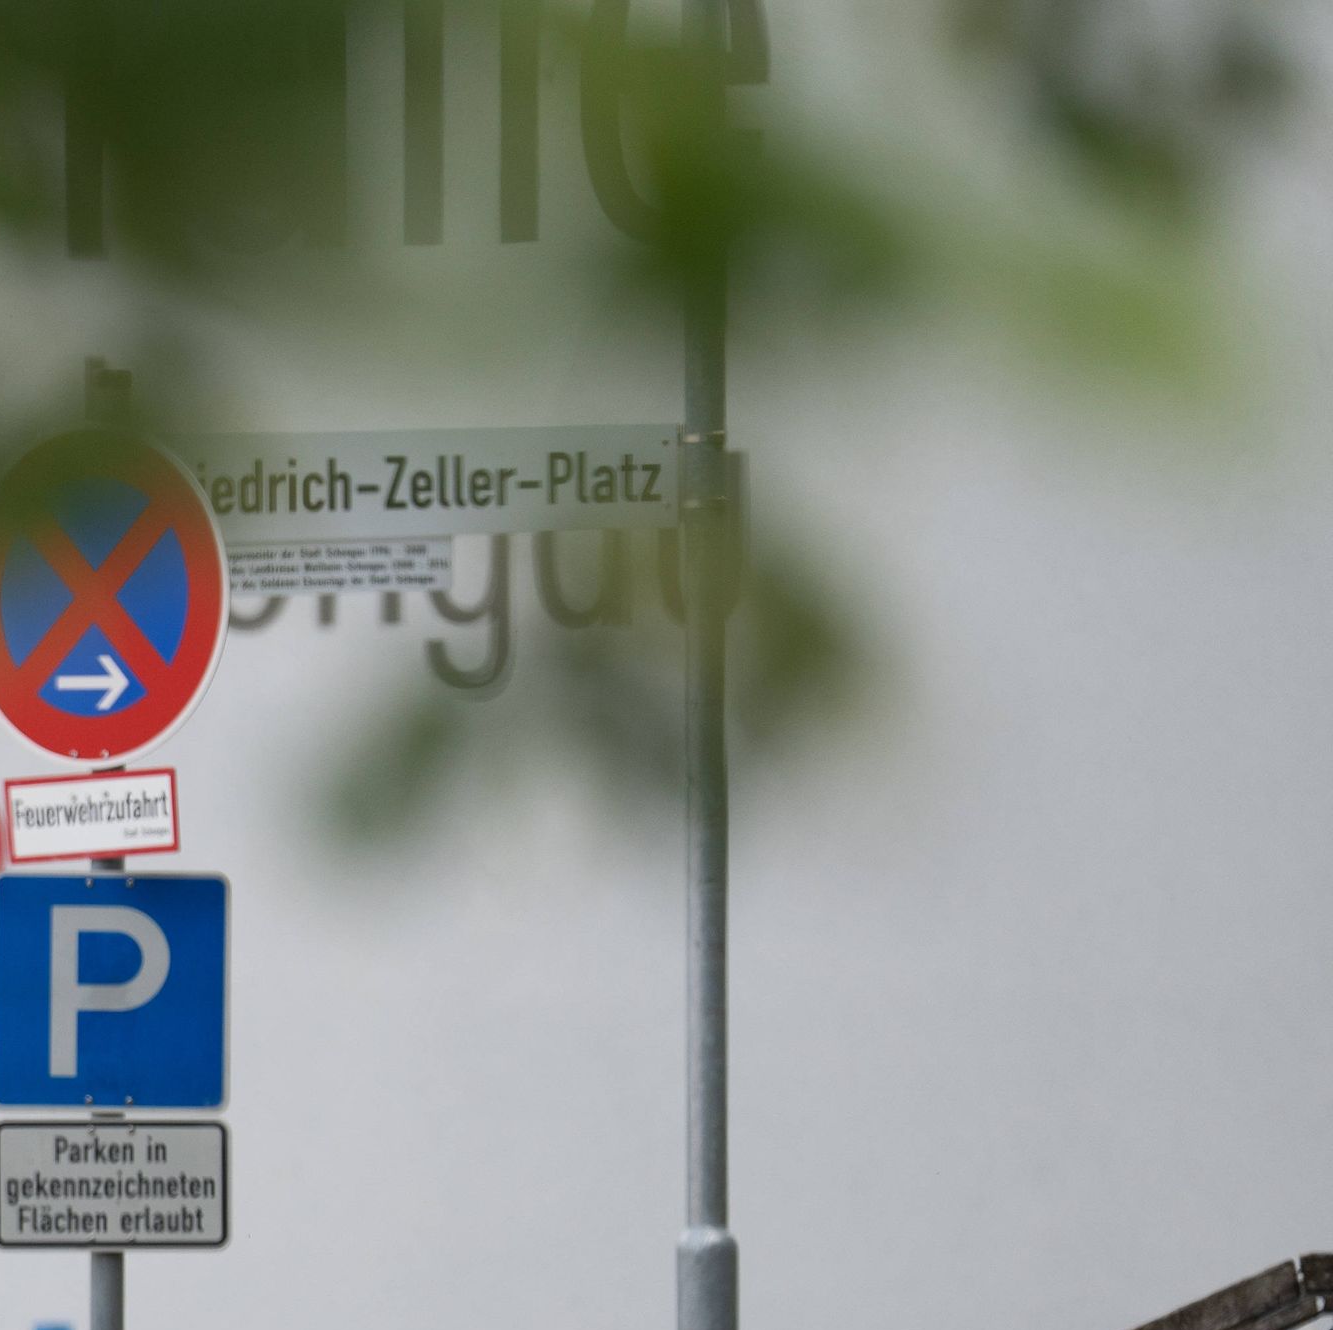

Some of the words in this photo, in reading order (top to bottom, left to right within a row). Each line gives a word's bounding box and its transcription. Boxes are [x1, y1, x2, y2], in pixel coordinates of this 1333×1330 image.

[196, 451, 663, 515] iedrich-Zeller-Platz
[15, 790, 169, 829] Feuerwehrzufahrt
[49, 904, 171, 1078] P
[54, 1135, 134, 1164] Parken
[146, 1135, 167, 1163] in
[6, 1170, 216, 1206] gekennzeichneten
[18, 1205, 107, 1234] Flächen
[120, 1205, 204, 1234] erlaubt
